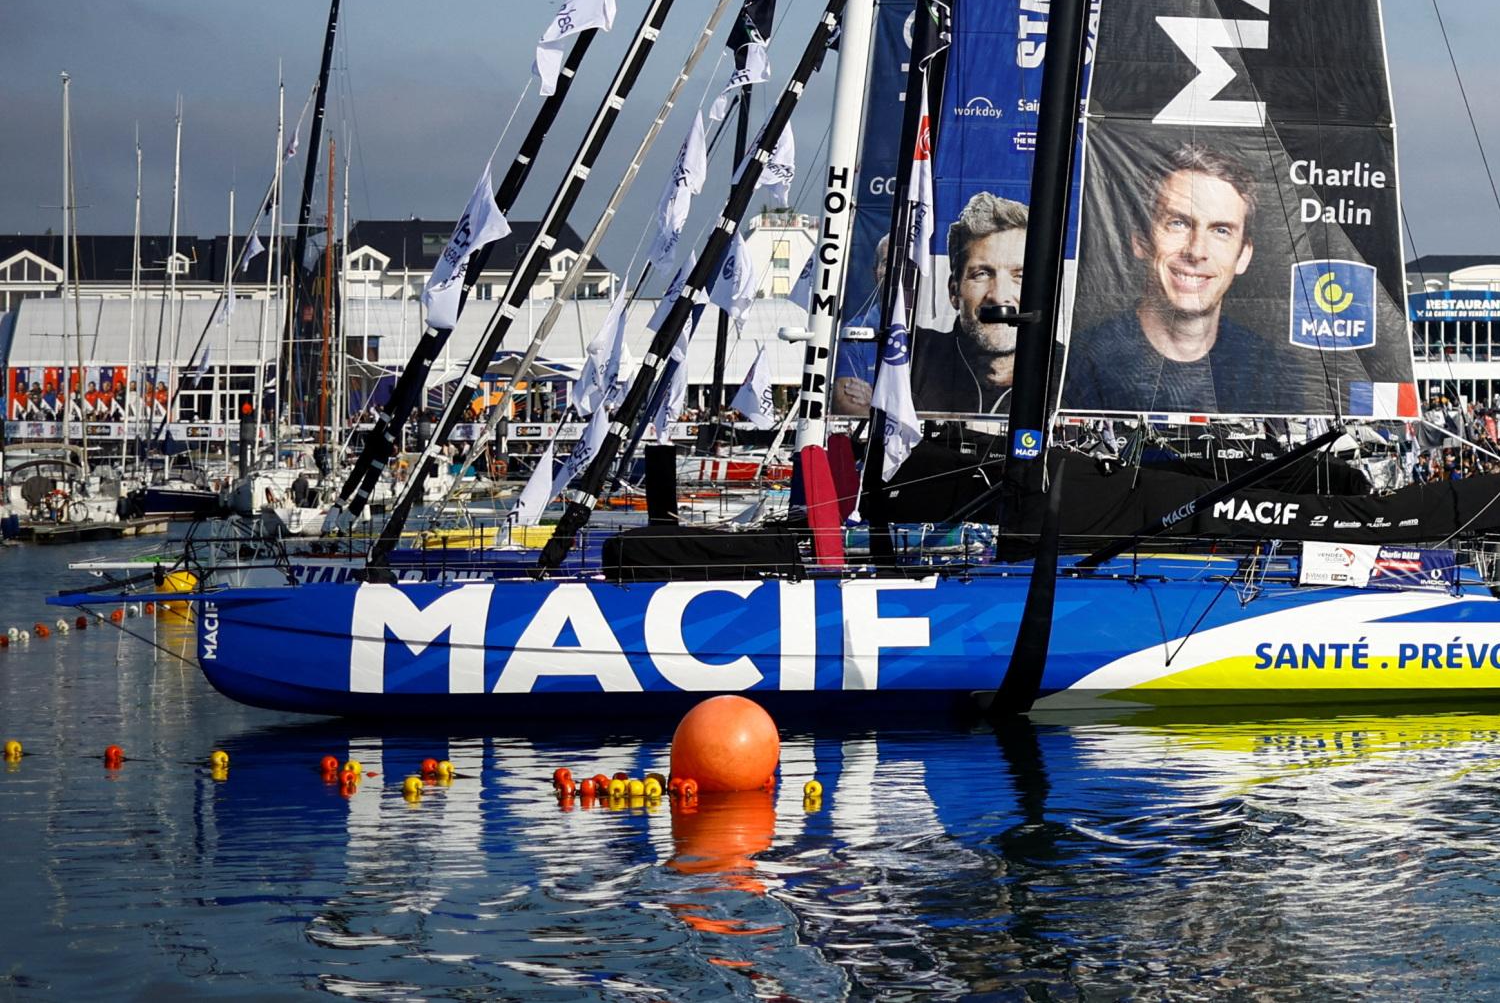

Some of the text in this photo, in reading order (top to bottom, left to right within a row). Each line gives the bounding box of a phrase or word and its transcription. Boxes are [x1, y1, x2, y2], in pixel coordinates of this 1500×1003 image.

[1289, 160, 1386, 189] Charlie
[1300, 198, 1372, 226] Dalin
[812, 166, 848, 317] HOLCIM
[1302, 318, 1366, 338] MACIF
[800, 346, 829, 419] PRB
[1014, 448, 1039, 458] MACIF
[1162, 500, 1196, 528] MACIF
[1213, 498, 1299, 525] MACIF
[203, 602, 219, 660] MACIF
[349, 578, 938, 694] MACIF
[1254, 636, 1369, 670] SANTÉ
[1381, 661, 1389, 670] .
